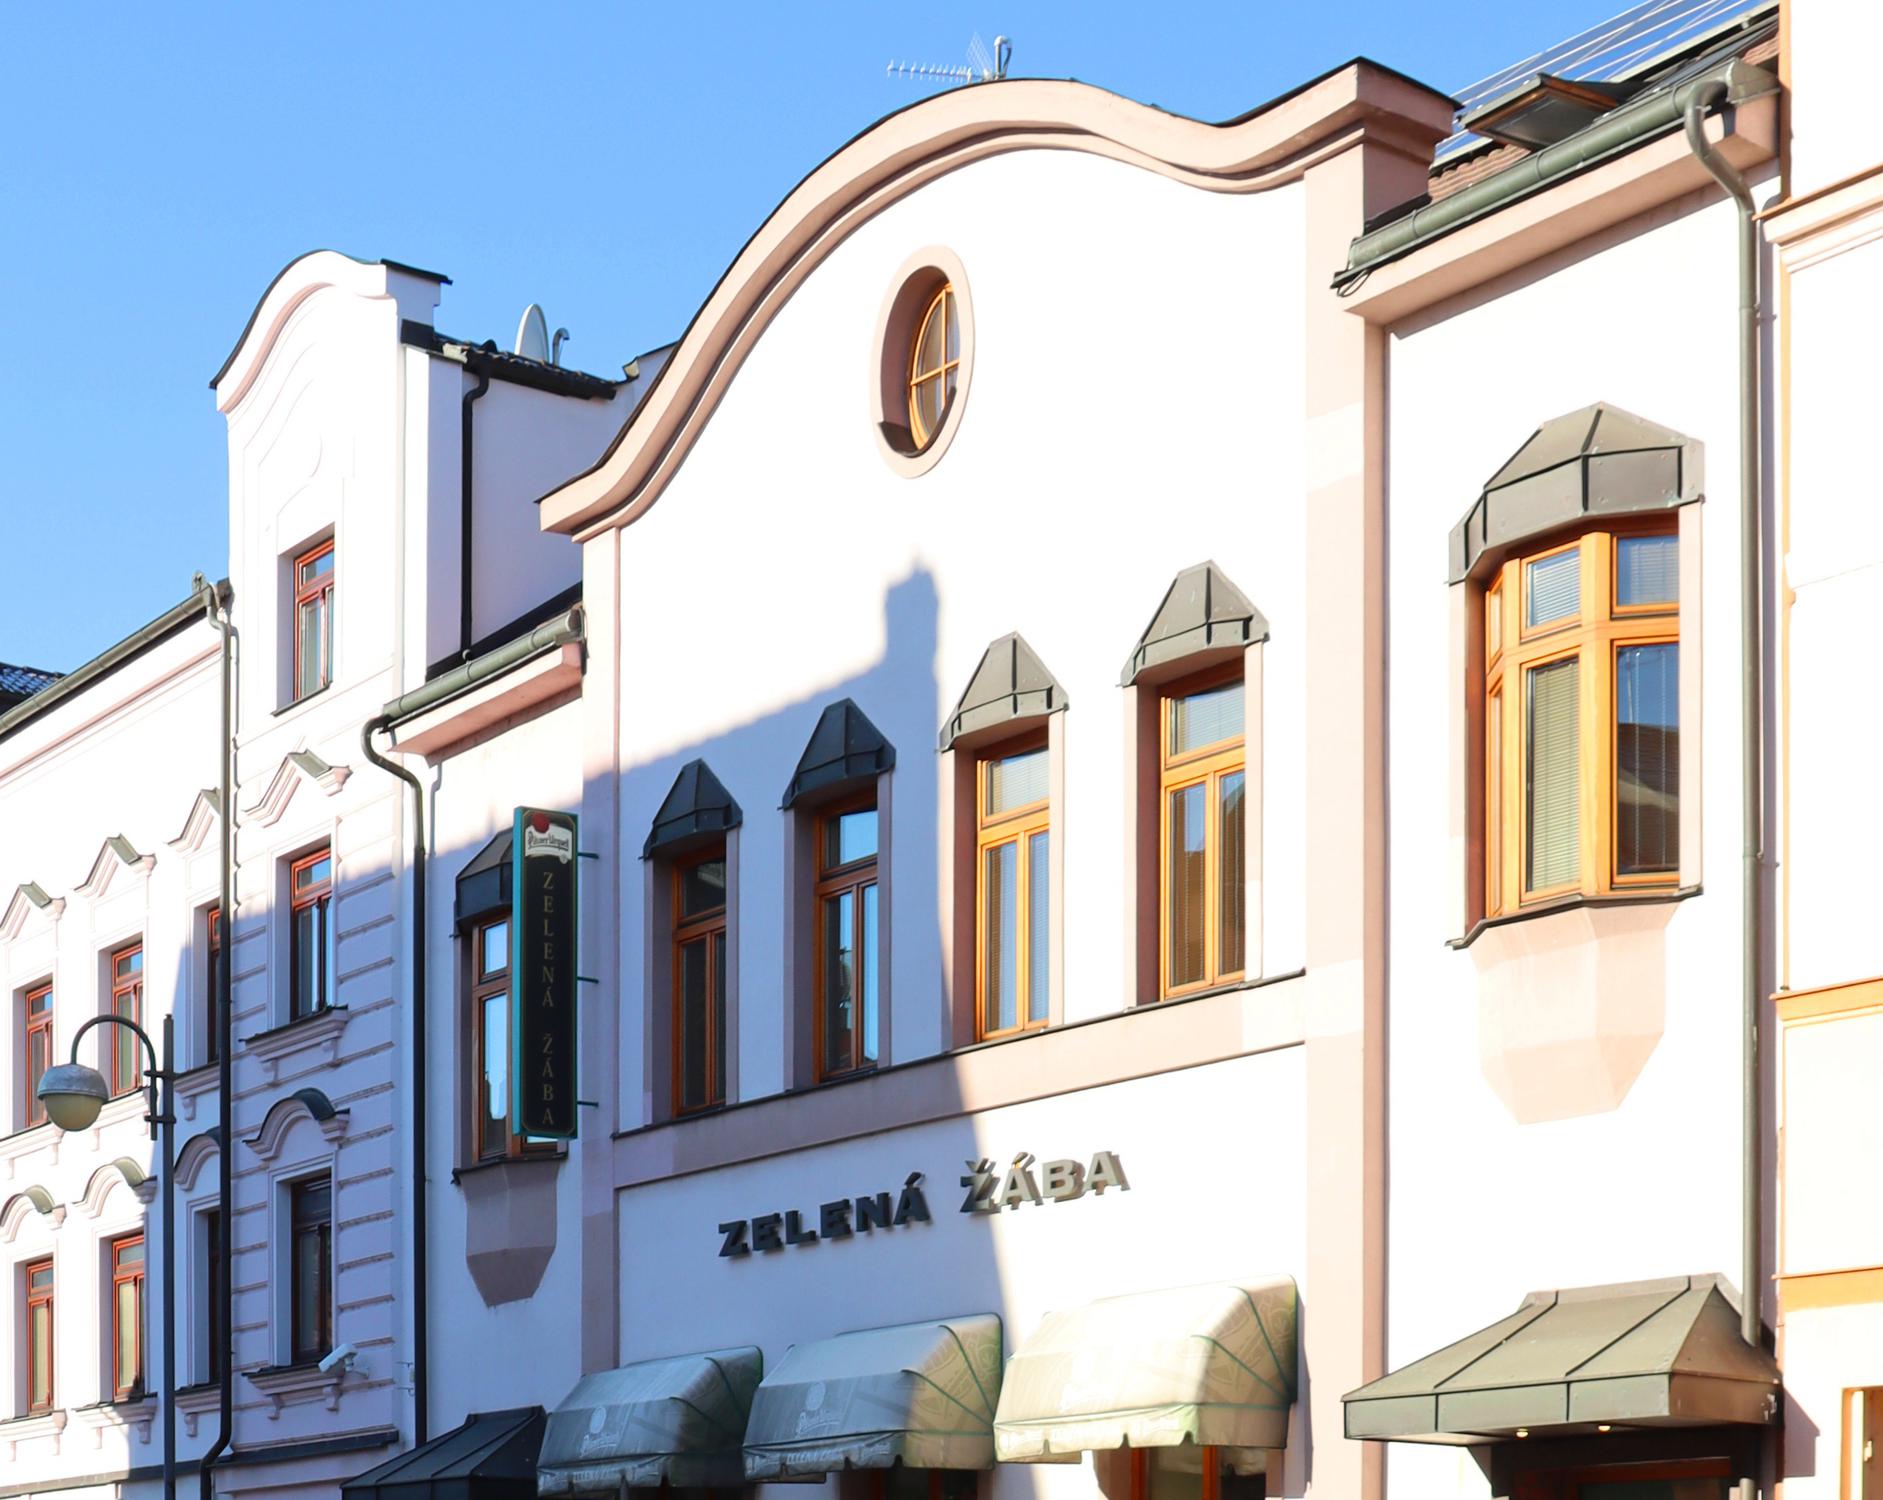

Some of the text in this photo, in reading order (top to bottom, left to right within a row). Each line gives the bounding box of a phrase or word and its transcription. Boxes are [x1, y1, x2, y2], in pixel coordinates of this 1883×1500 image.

[542, 872, 554, 1126] ZELENÁ ŽÁBA
[718, 1150, 1131, 1258] ZELENÁ ŽÁBA
